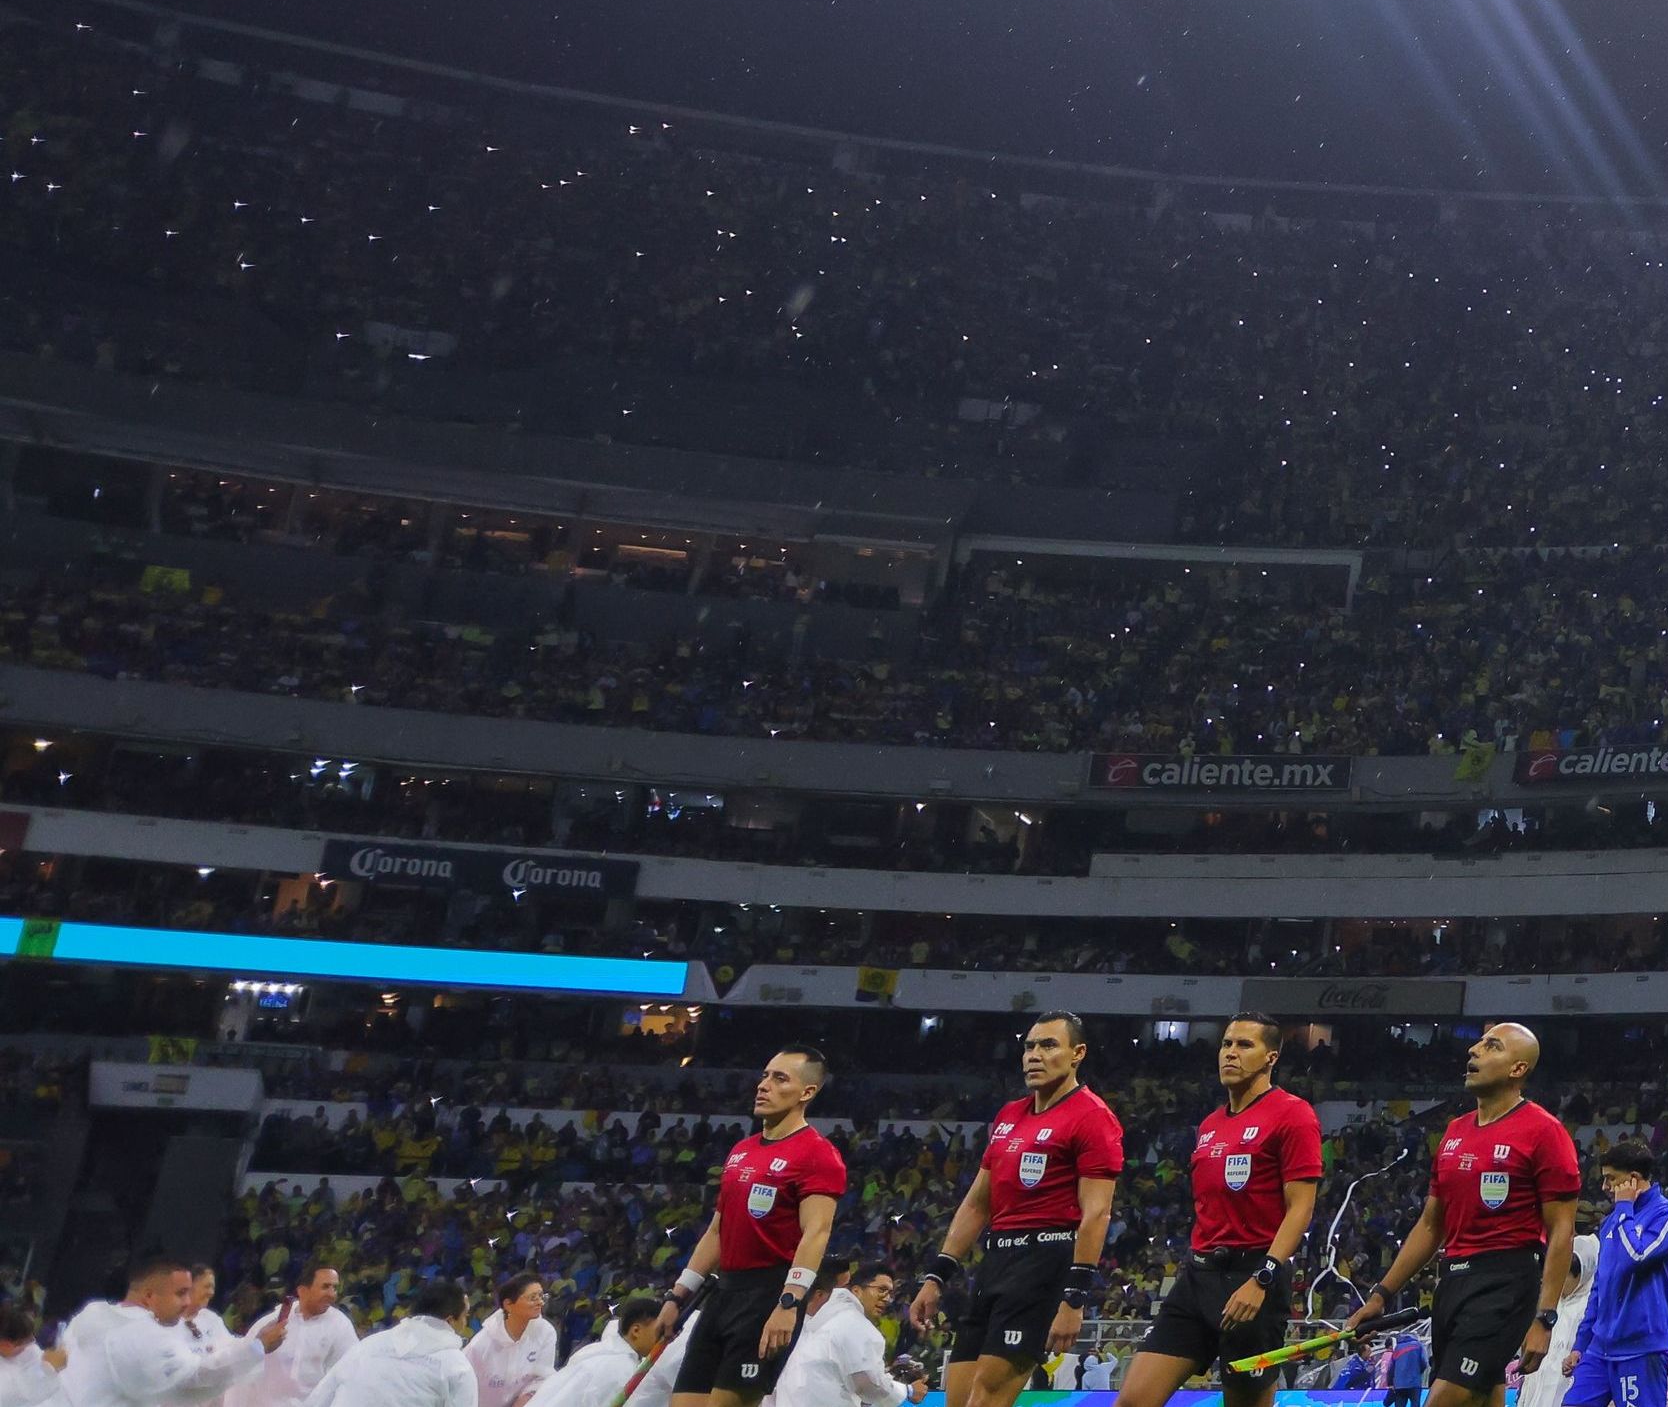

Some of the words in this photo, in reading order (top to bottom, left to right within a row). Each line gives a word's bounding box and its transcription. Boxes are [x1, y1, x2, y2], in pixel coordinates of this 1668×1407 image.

[1142, 756, 1334, 786] caliente.mx
[350, 848, 453, 880] Corona
[502, 859, 602, 889] Corona
[1023, 1155, 1043, 1165] FIFA
[1228, 1157, 1248, 1166] FIFA
[1483, 1174, 1506, 1185] FIFA
[753, 1186, 774, 1197] FIFA
[1620, 1375, 1639, 1401] 15
